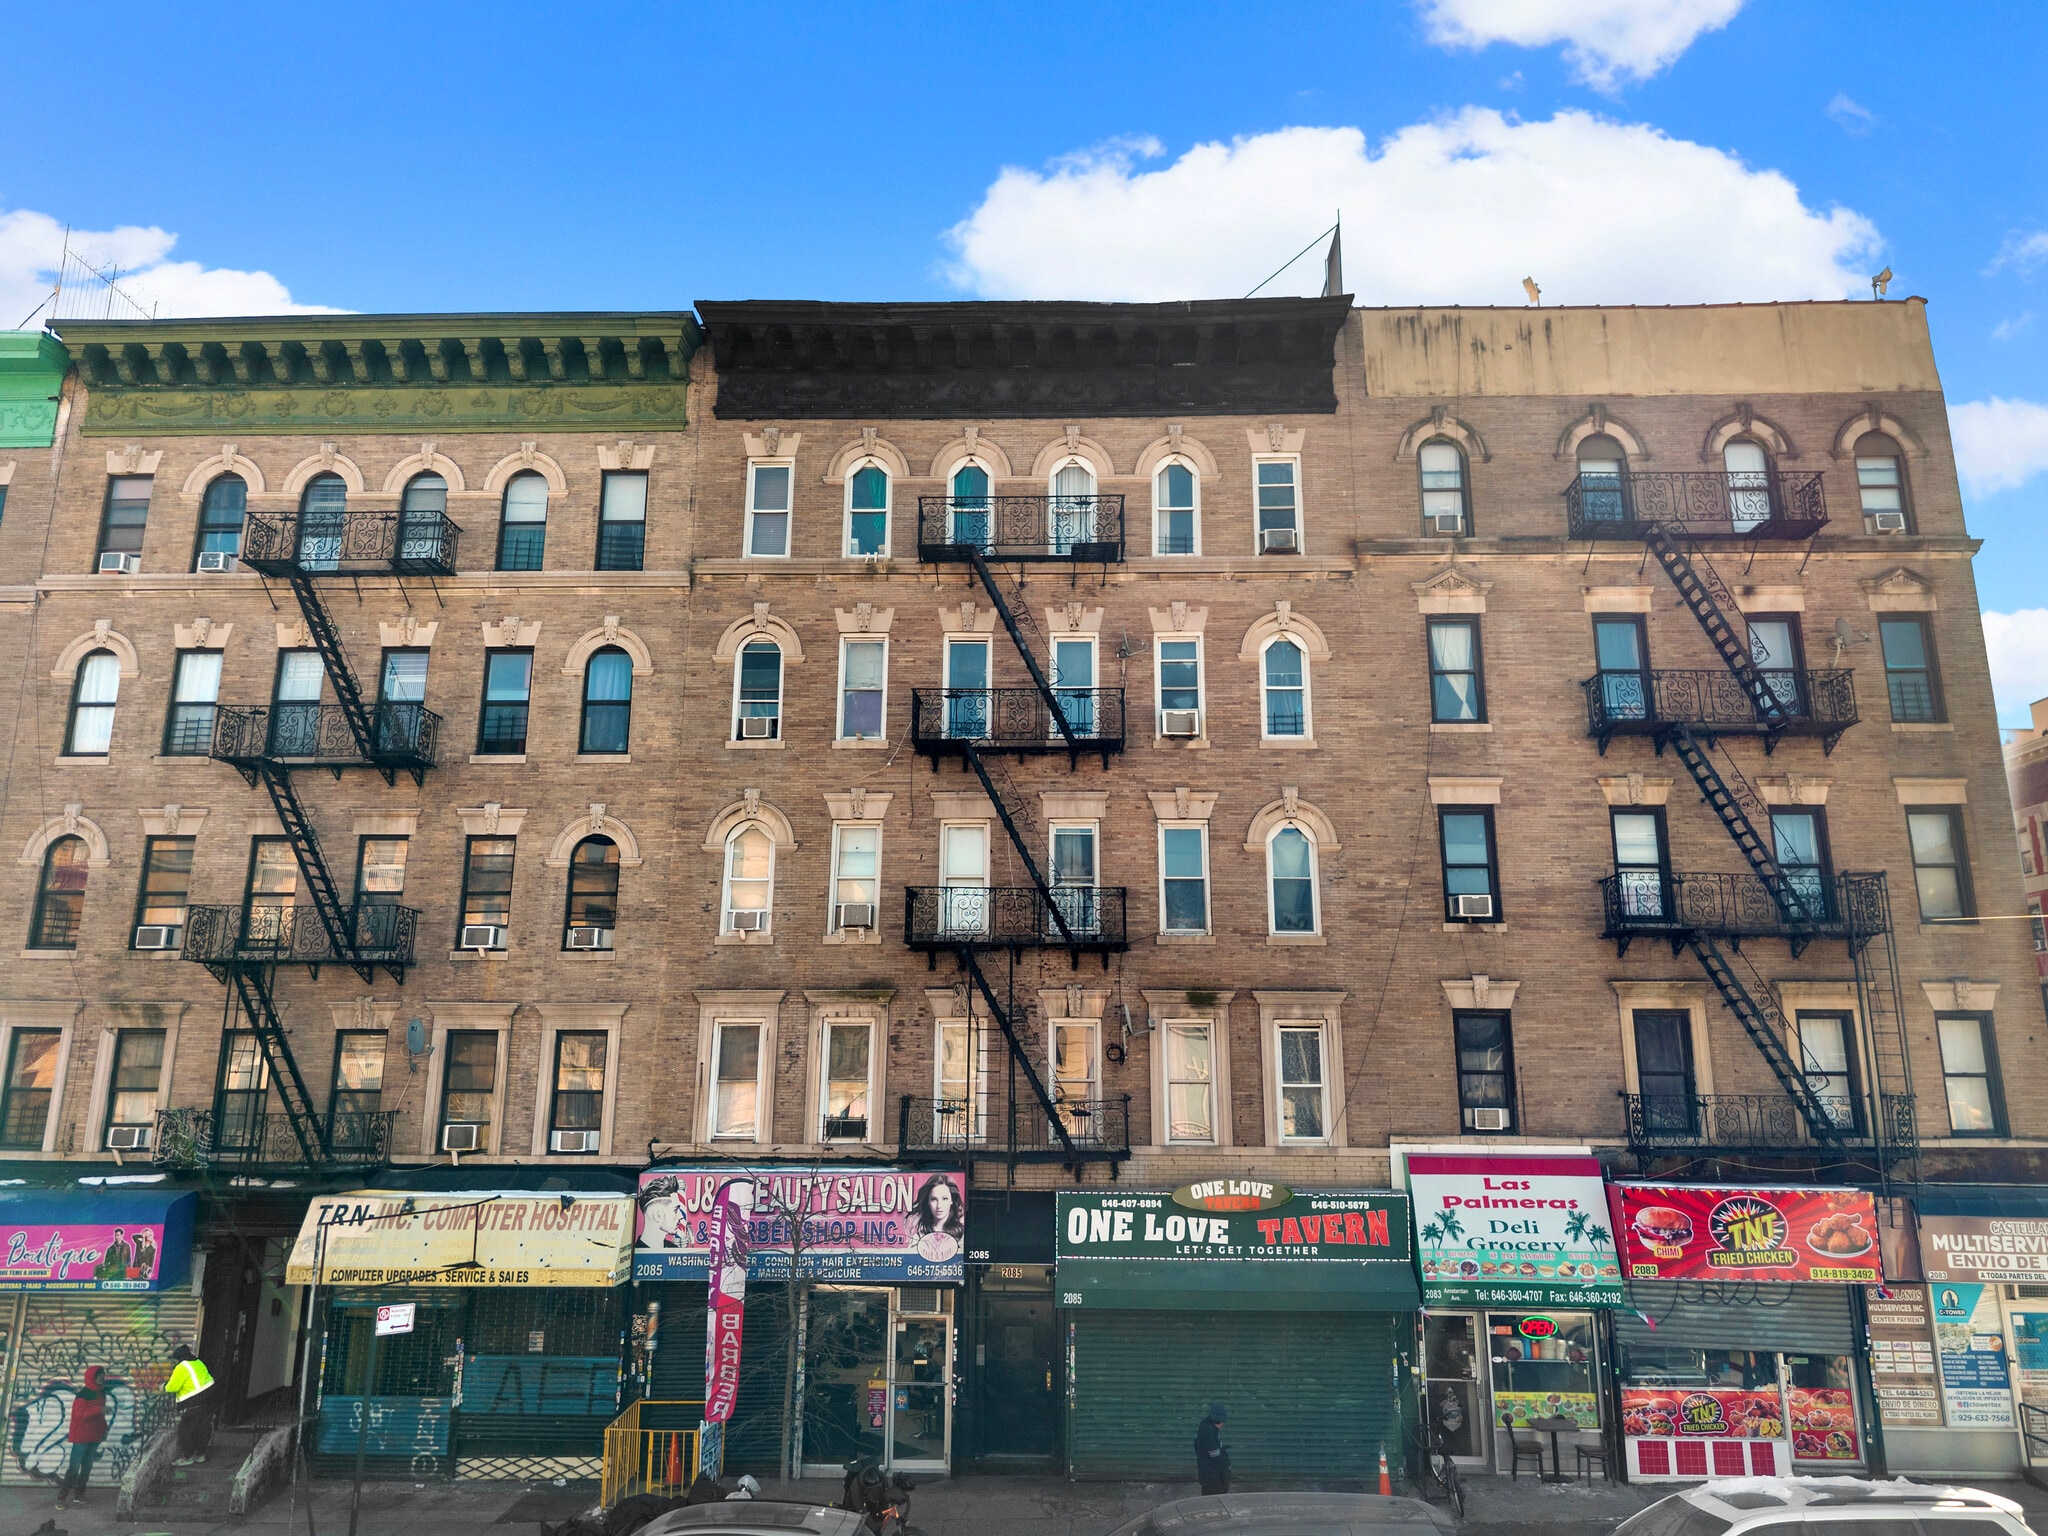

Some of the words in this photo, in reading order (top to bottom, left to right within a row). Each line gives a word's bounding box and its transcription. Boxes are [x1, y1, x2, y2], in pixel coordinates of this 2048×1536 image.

[1190, 1180, 1225, 1199] ONE
[1229, 1180, 1273, 1199] LOVE
[1483, 1177, 1531, 1191] Las
[752, 1176, 833, 1212] EAUTY
[837, 1176, 913, 1213] SALON
[1101, 1199, 1162, 1208] 646-407-6894
[1204, 1195, 1261, 1210] TAVERN
[1311, 1201, 1370, 1210] 646-510-5679
[1442, 1196, 1579, 1210] Palmeras
[423, 1203, 527, 1231] COMPUTER
[528, 1203, 620, 1231] HOSPITAL
[803, 1220, 856, 1244] SHOP
[864, 1220, 904, 1244] INC.
[1067, 1207, 1134, 1244] ONE
[1144, 1213, 1230, 1245] LOVE
[1257, 1209, 1391, 1248] TAVERN
[1488, 1219, 1540, 1235] Deli
[1728, 1211, 1778, 1251] TNT
[1990, 1221, 2048, 1236] CASTELLA
[1176, 1245, 1212, 1254] LET'S
[1219, 1246, 1243, 1255] GET
[1249, 1246, 1319, 1256] TOGETHER
[1466, 1236, 1567, 1251] Grocery
[1932, 1234, 2048, 1254] MULTISERVI
[7, 1231, 102, 1280] Boutique
[968, 1250, 990, 1259] 2085
[1656, 1247, 1680, 1257] CHIMI
[1713, 1252, 1744, 1265] FRIED
[1746, 1251, 1793, 1265] CHICKEN
[765, 1256, 814, 1266] CONDIION
[822, 1256, 843, 1267] HAIR
[846, 1256, 903, 1267] EXTENSIONS
[1952, 1254, 2010, 1268] ENVIO
[2016, 1256, 2041, 1269] DE
[331, 1269, 384, 1282] COMPUTER
[386, 1270, 437, 1283] UPGRADES
[445, 1270, 487, 1283] SERVICE
[488, 1270, 496, 1283] &
[636, 1264, 663, 1277] 2085
[817, 1268, 861, 1278] PEDICURE
[907, 1265, 963, 1278] 646-575-5536
[1002, 1268, 1022, 1277] 2085
[1634, 1266, 1657, 1275] 2083
[1812, 1269, 1874, 1280] 914-819-3492
[1063, 1292, 1083, 1305] 2085
[1425, 1289, 1442, 1299] 2083
[1474, 1289, 1490, 1301] Tel:
[1491, 1289, 1543, 1302] 646-360-4707
[1550, 1291, 1568, 1303] Fax:
[1569, 1292, 1622, 1304] 646-360-2192
[1521, 1320, 1555, 1335] OPEN
[1691, 1402, 1717, 1424] TNT
